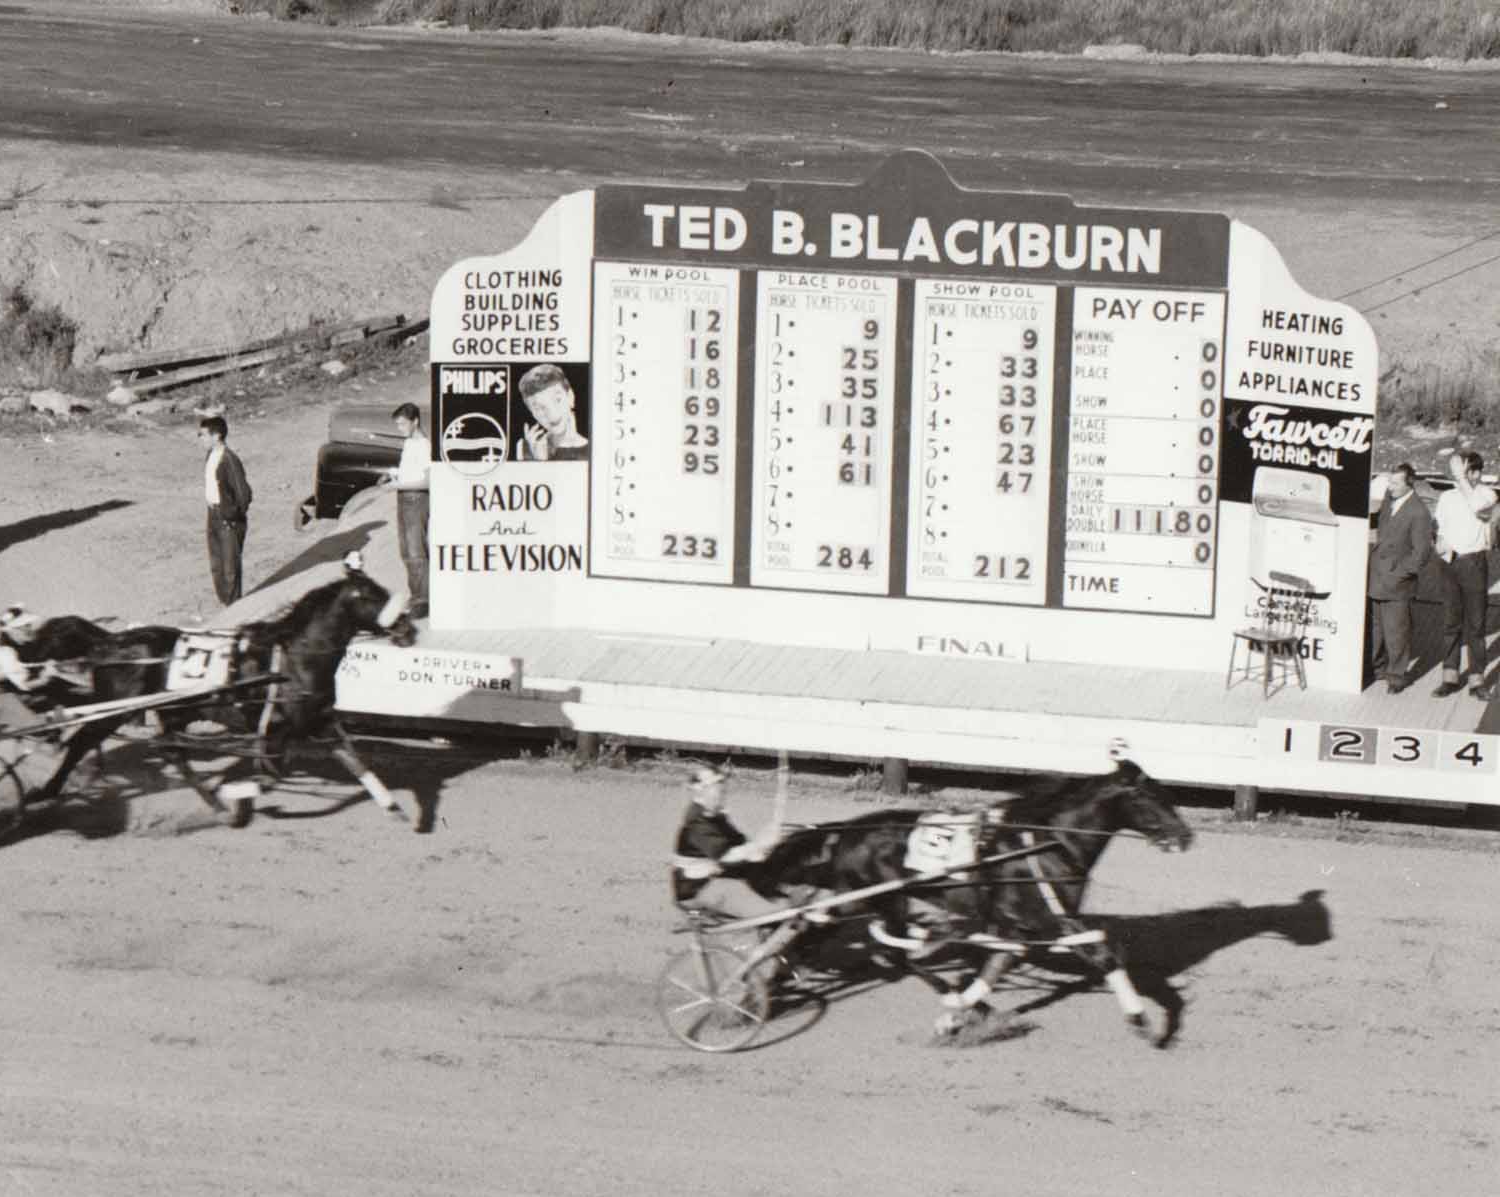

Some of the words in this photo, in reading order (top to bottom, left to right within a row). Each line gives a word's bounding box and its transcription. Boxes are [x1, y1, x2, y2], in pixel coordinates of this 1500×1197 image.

[644, 204, 748, 251] TED
[772, 210, 817, 256] B.
[830, 213, 1161, 273] BLACKBURN
[465, 270, 563, 289] CLOTHING
[629, 267, 659, 278] WIN
[665, 269, 710, 281] POOL
[778, 274, 828, 289] PLACE
[837, 278, 881, 290] POOL
[465, 292, 558, 311] BUILDING
[933, 284, 981, 295] SHOW
[989, 286, 1034, 298] POOL
[691, 309, 721, 332] 12
[1092, 297, 1142, 320] PAY
[1152, 300, 1205, 323] OFF
[462, 314, 560, 332] SUPPLIES
[864, 320, 878, 340] 9
[1262, 309, 1344, 336] HEATING
[452, 337, 568, 355] GROCERIES
[691, 338, 720, 360] 16
[1023, 329, 1038, 350] 9
[843, 347, 879, 371] 25
[1248, 340, 1355, 369] FURNITURE
[690, 367, 720, 389] 18
[1000, 356, 1037, 378] 33
[1075, 365, 1109, 380] PLACE
[442, 369, 506, 394] PHILIPS
[842, 377, 878, 399] 35
[1239, 371, 1362, 402] APPLIANCES
[685, 396, 720, 417] 69
[1000, 385, 1037, 407] 33
[1075, 396, 1107, 408] SHOW
[826, 405, 877, 428] 113
[1000, 414, 1035, 437] 67
[684, 424, 719, 447] 23
[1242, 404, 1374, 453] Fawcett
[841, 434, 871, 456] 41
[998, 443, 1035, 465] 23
[1250, 440, 1344, 471] TORRID-OIL
[684, 452, 719, 475] 95
[839, 462, 871, 485] 61
[997, 472, 1033, 493] 47
[472, 484, 553, 511] RADIO
[478, 520, 536, 535] And
[436, 544, 583, 572] TELEVISION
[662, 535, 717, 559] 233
[817, 545, 873, 570] 284
[975, 555, 1030, 580] 212
[1067, 575, 1120, 594] TIME
[917, 636, 1016, 658] FINAL
[399, 671, 433, 683] DON
[444, 674, 512, 691] TURNER
[1284, 728, 1292, 752] 1
[1332, 731, 1362, 757] 2
[1392, 736, 1421, 762] 3
[1455, 742, 1483, 766] 4
